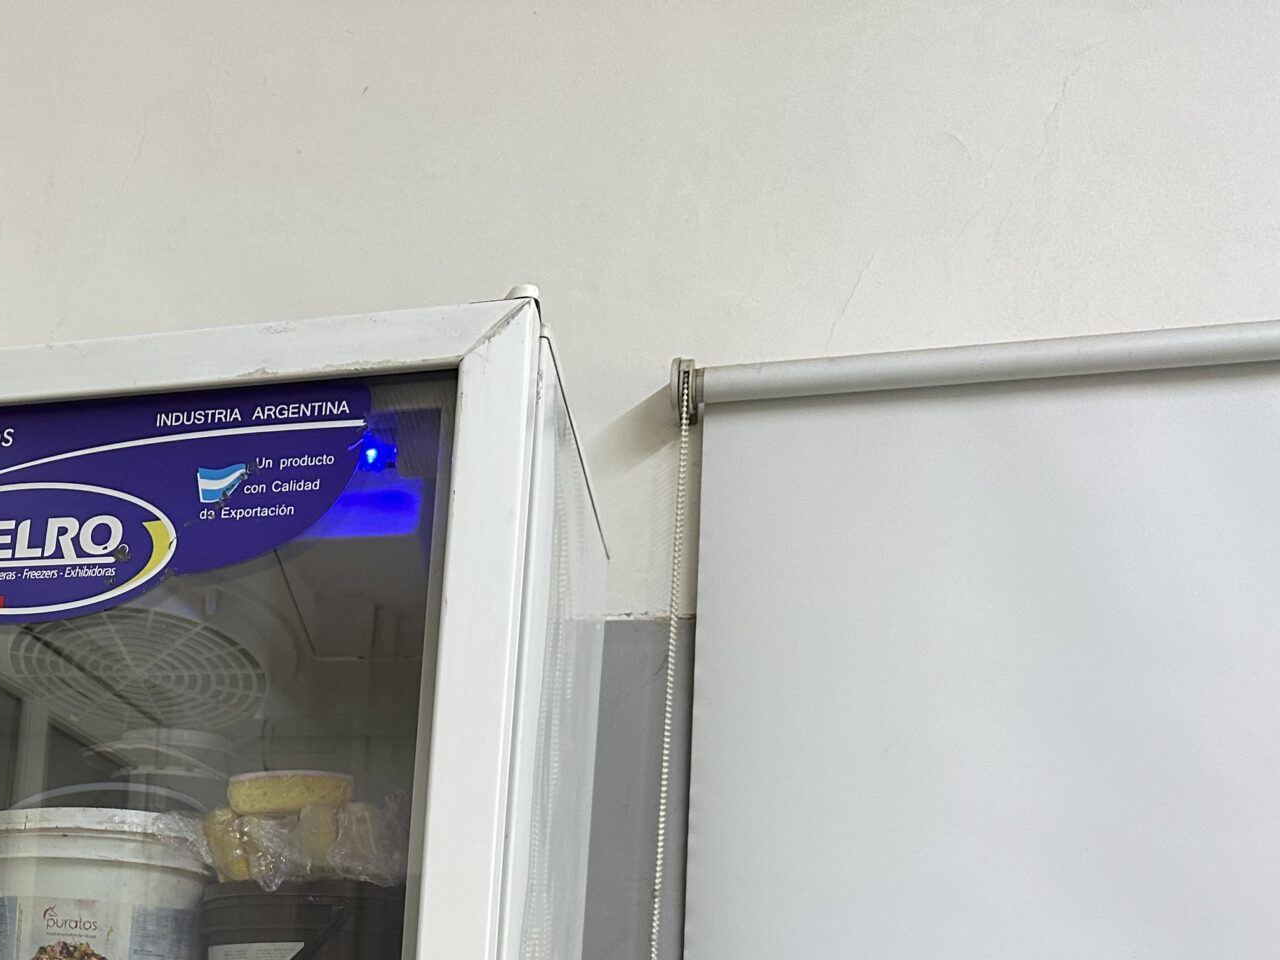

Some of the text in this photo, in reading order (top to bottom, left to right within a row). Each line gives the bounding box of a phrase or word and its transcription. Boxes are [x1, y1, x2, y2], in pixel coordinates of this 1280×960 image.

[156, 400, 350, 427] INDUSTRIA ARGENTINA
[256, 454, 335, 470] Un producto
[243, 479, 320, 494] con Calidad
[221, 504, 294, 521] Exportación
[22, 567, 58, 580] Freezers
[64, 565, 117, 578] Exhibidoras
[46, 914, 98, 932] puratos
